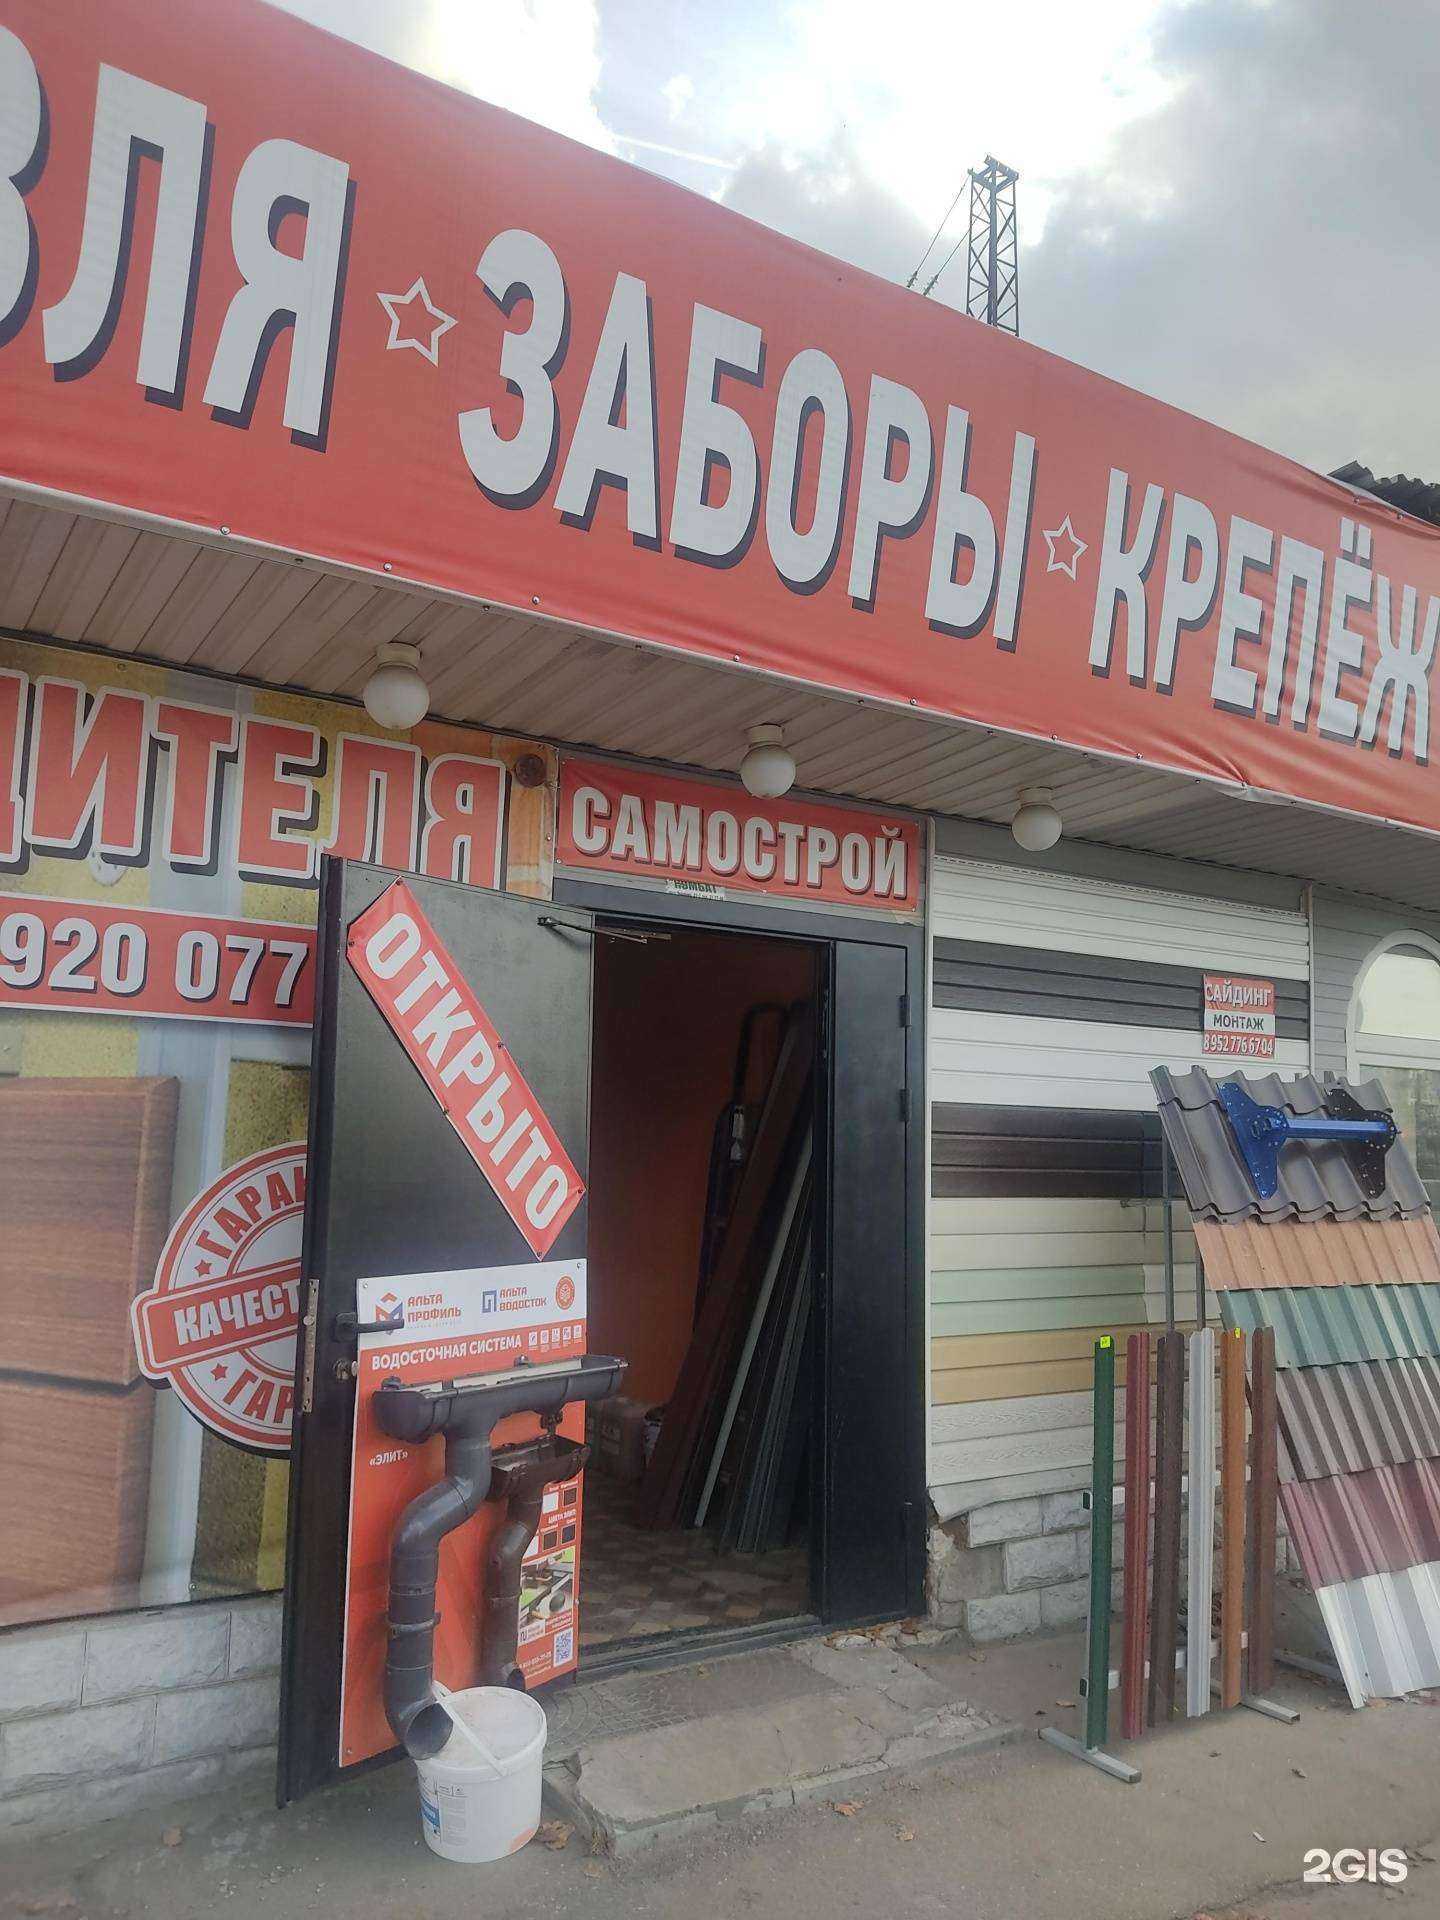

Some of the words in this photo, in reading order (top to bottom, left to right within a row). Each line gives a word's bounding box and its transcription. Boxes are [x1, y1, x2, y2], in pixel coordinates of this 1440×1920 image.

[458, 228, 1040, 654] ЗАБОРЫ
[1088, 467, 1440, 768] КРЕПЁЖ
[0, 668, 513, 891] ИТЕЛЯ
[572, 786, 908, 900] САМОСТРОЙ
[0, 911, 147, 997] 920
[174, 929, 309, 1006] 077
[1204, 979, 1272, 1008] САЙДИНГ
[1213, 1014, 1264, 1031] МОНТАЖ
[365, 912, 569, 1231] ОТКРЫТО
[407, 1293, 443, 1308] АЛЬТА
[499, 1286, 528, 1299] АЛЬТА
[499, 1297, 548, 1312] ВОДОСТОК
[407, 1305, 462, 1323] ПРОФИЛЬ
[371, 1344, 467, 1371] ВОДОСТОЧНАЯ
[469, 1333, 522, 1356] СИСТЕМА
